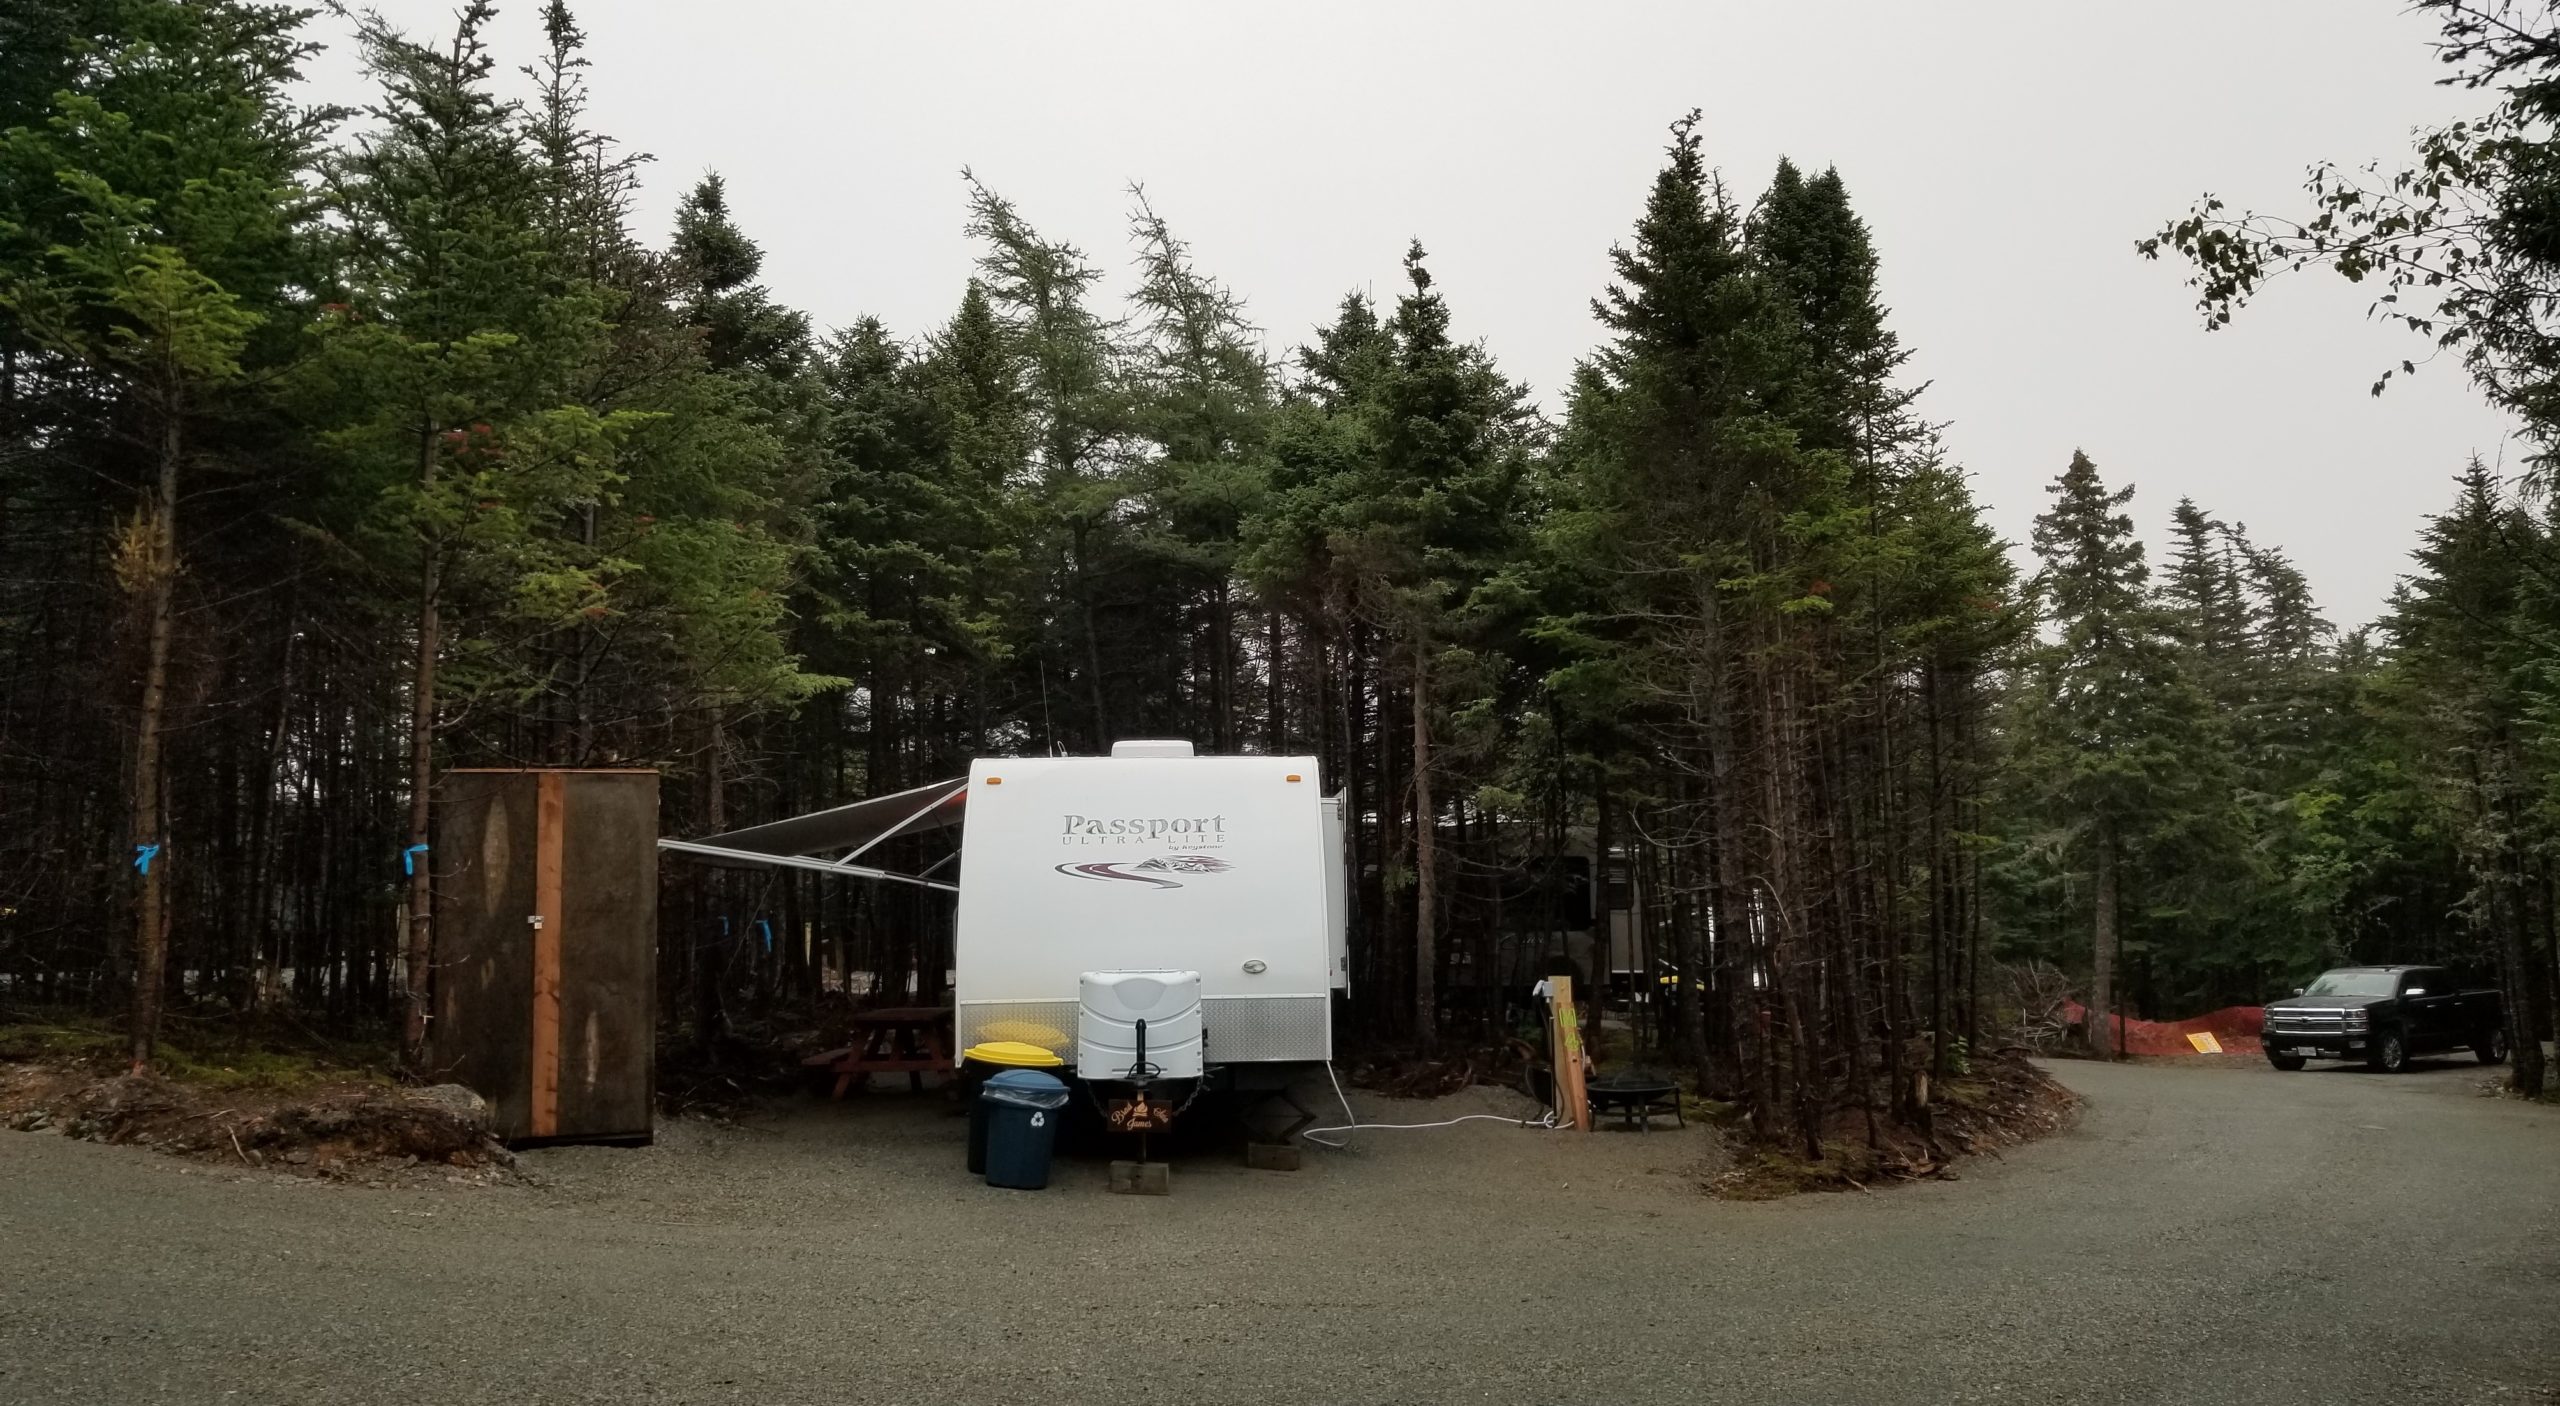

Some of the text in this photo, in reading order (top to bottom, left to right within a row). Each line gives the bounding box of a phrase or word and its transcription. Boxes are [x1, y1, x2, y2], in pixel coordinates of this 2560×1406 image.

[1062, 814, 1226, 839] Passport
[1062, 834, 1226, 845] ULTRA LITE
[1127, 1117, 1152, 1131] James
